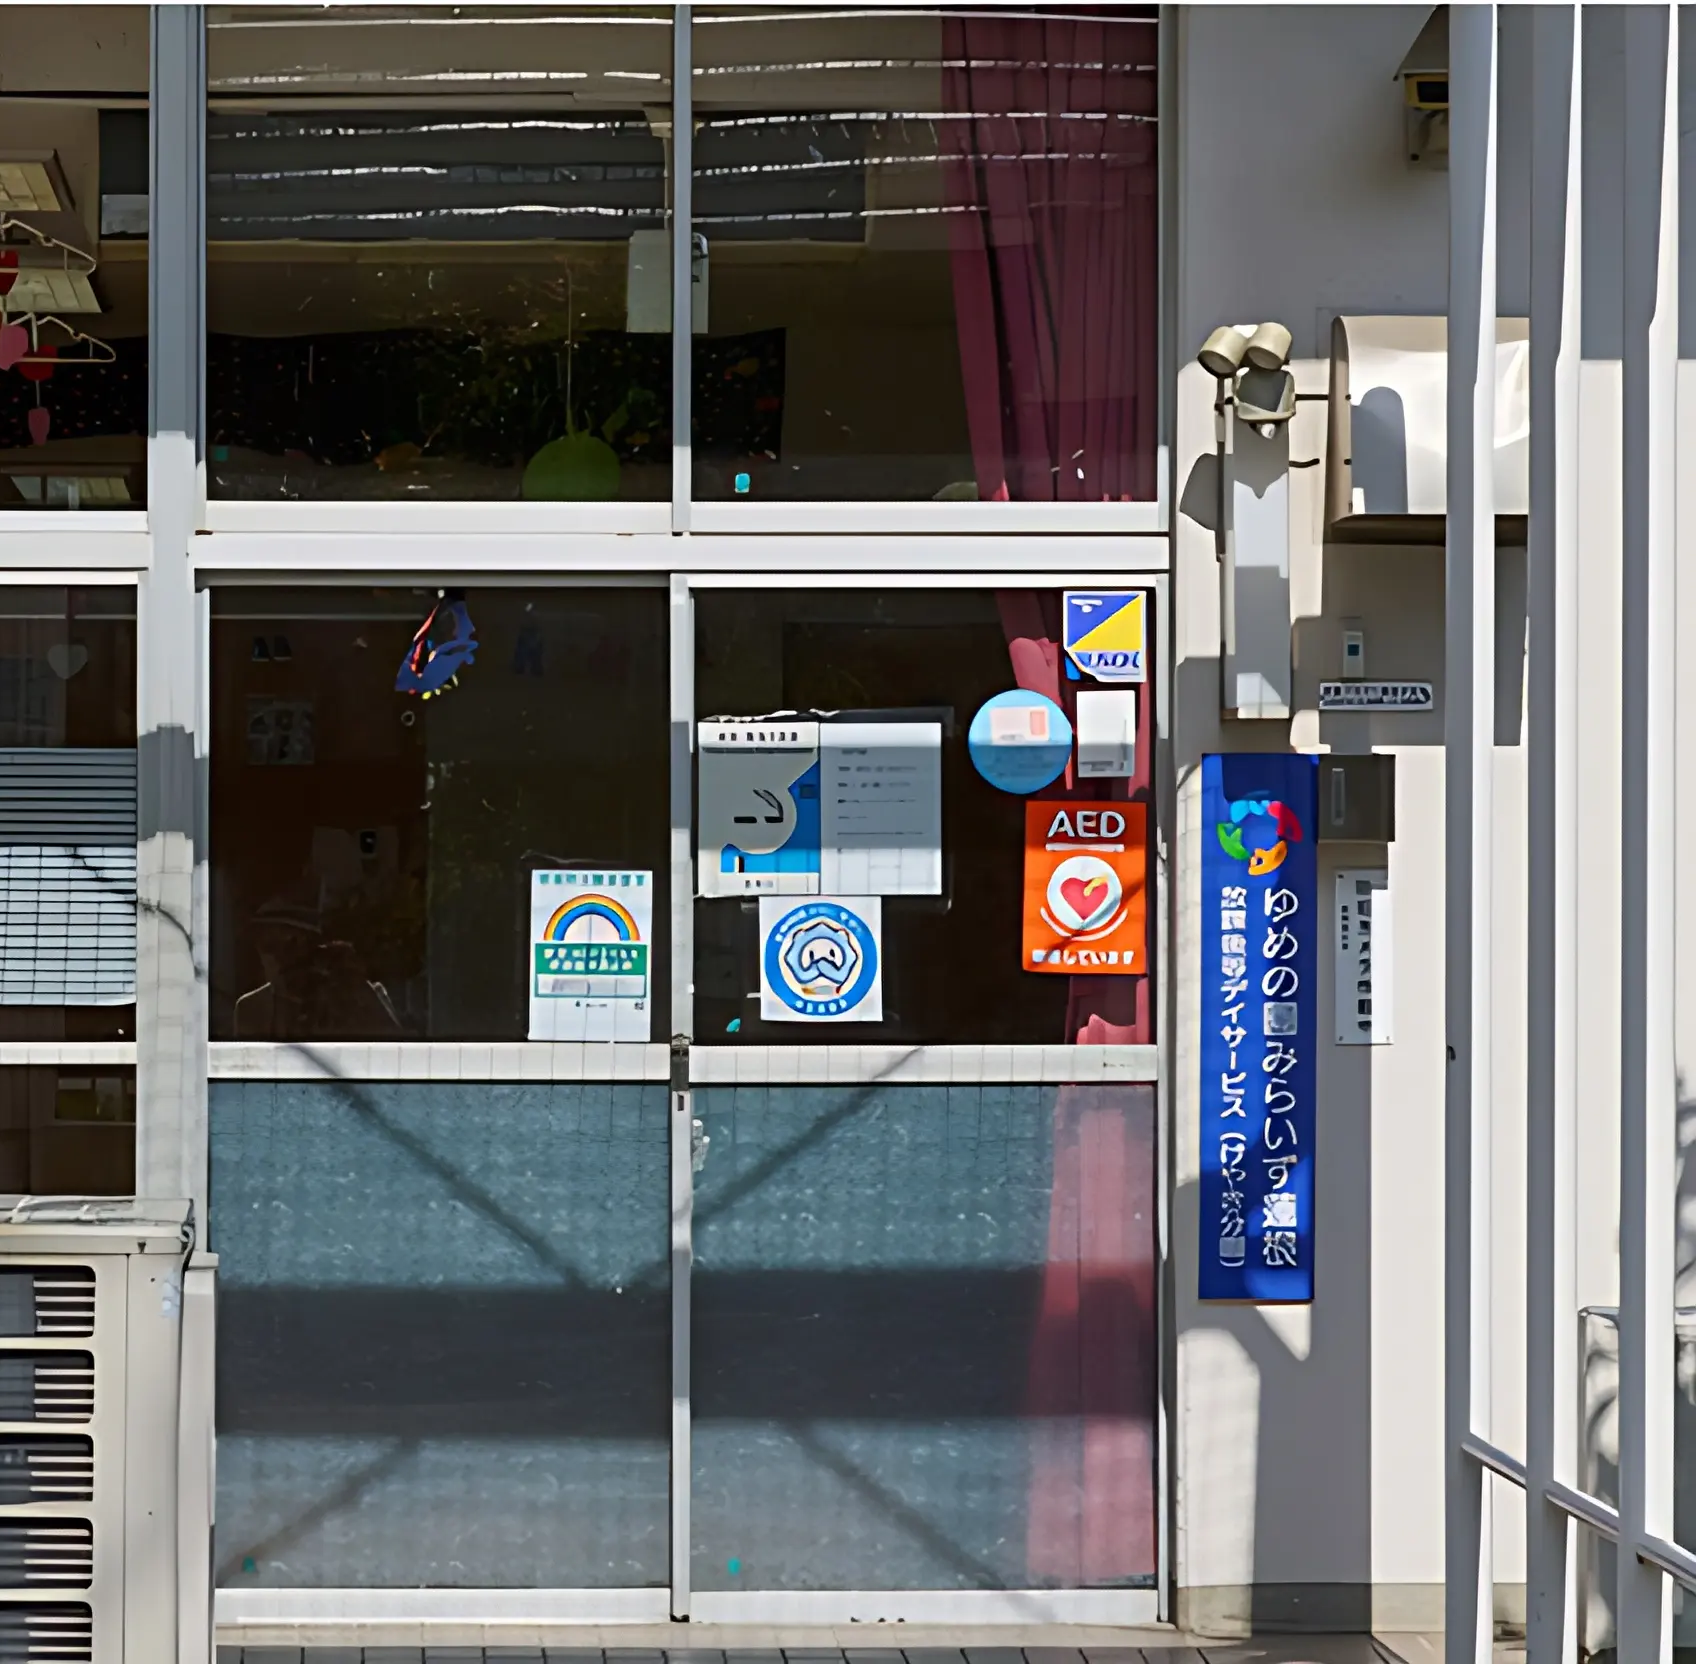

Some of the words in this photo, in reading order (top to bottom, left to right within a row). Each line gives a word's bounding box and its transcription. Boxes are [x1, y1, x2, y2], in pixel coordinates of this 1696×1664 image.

[1047, 810, 1126, 838] AED
[1261, 887, 1299, 1266] ゆめのみらいず
